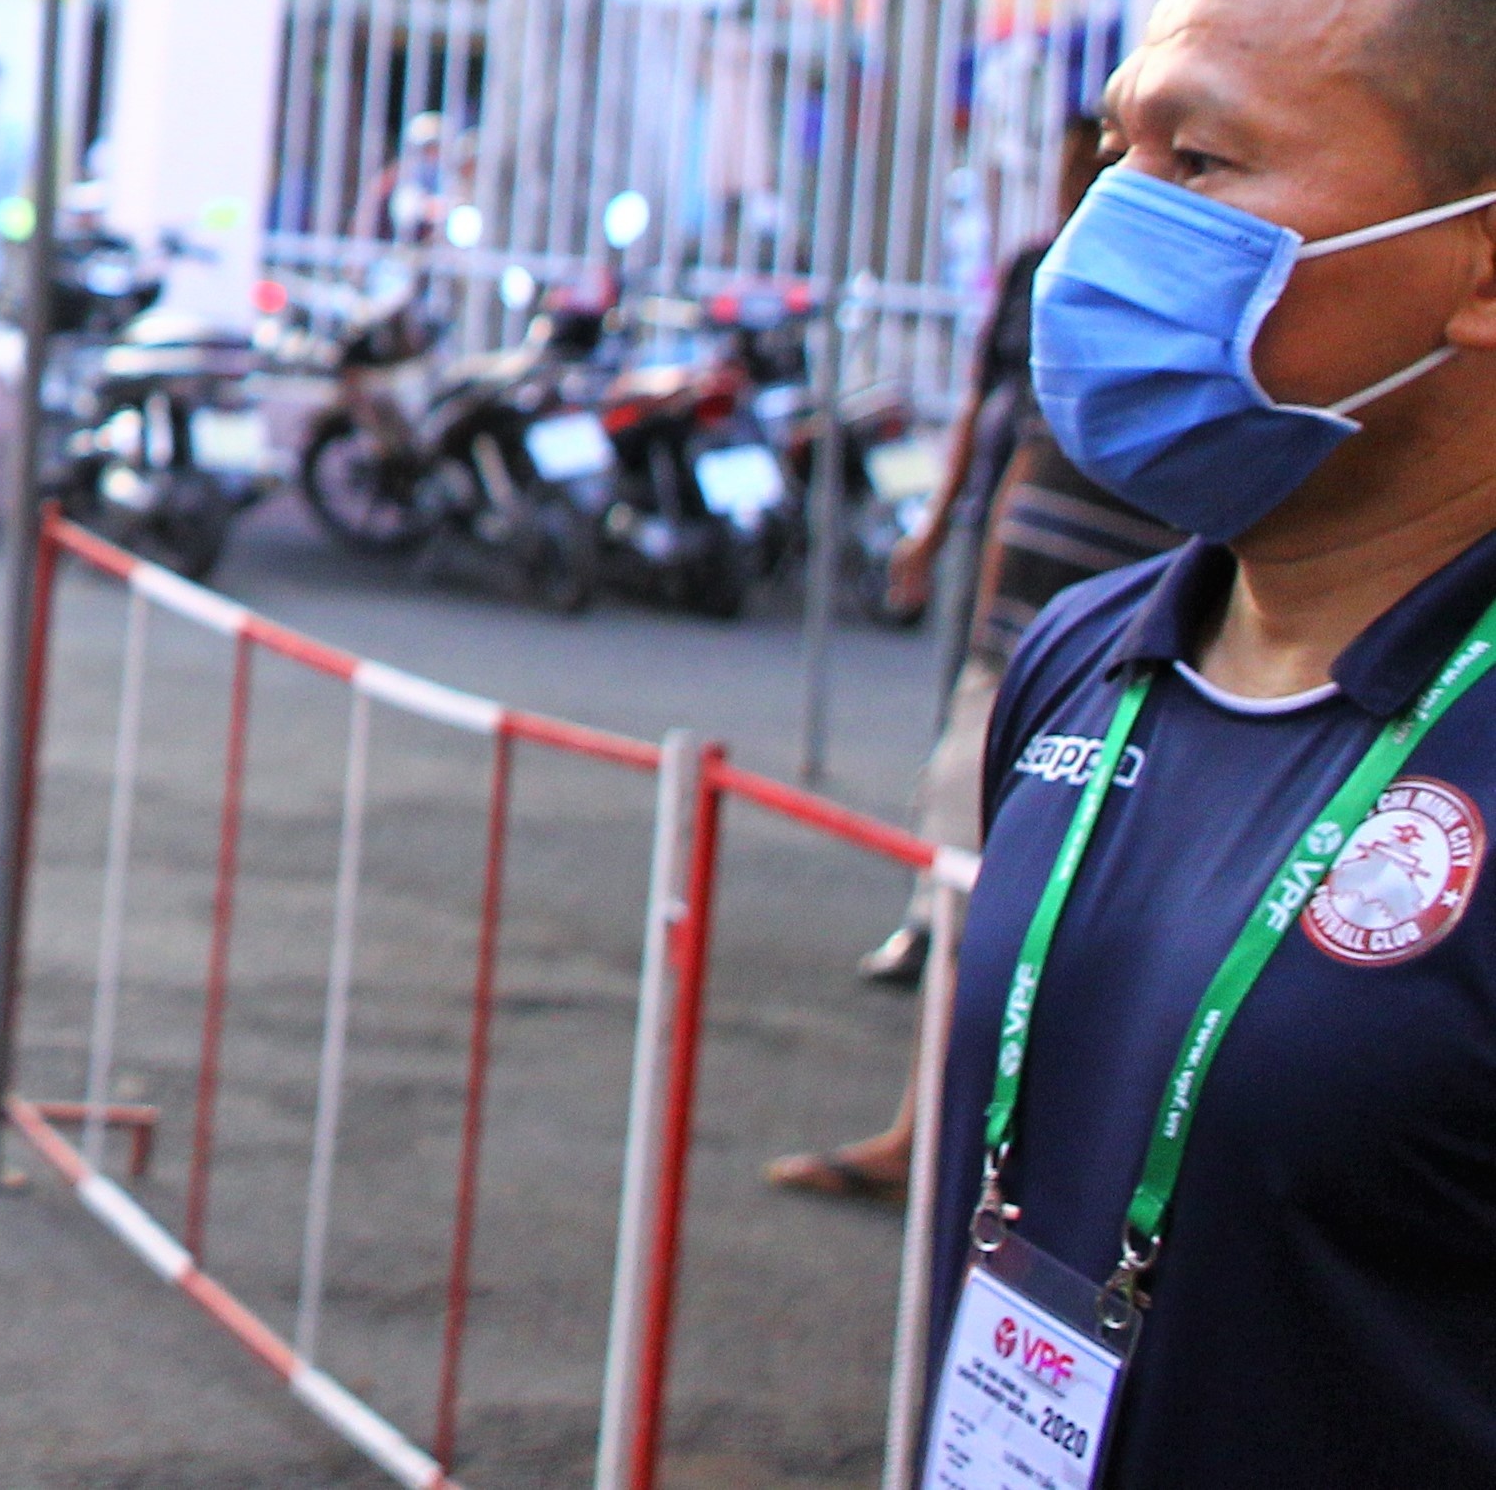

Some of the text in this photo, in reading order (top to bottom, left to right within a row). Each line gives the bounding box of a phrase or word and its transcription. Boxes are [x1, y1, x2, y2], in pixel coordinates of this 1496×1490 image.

[1266, 862, 1325, 933] VPF
[1023, 1328, 1075, 1386] VPF
[1040, 1407, 1088, 1459] 2020
